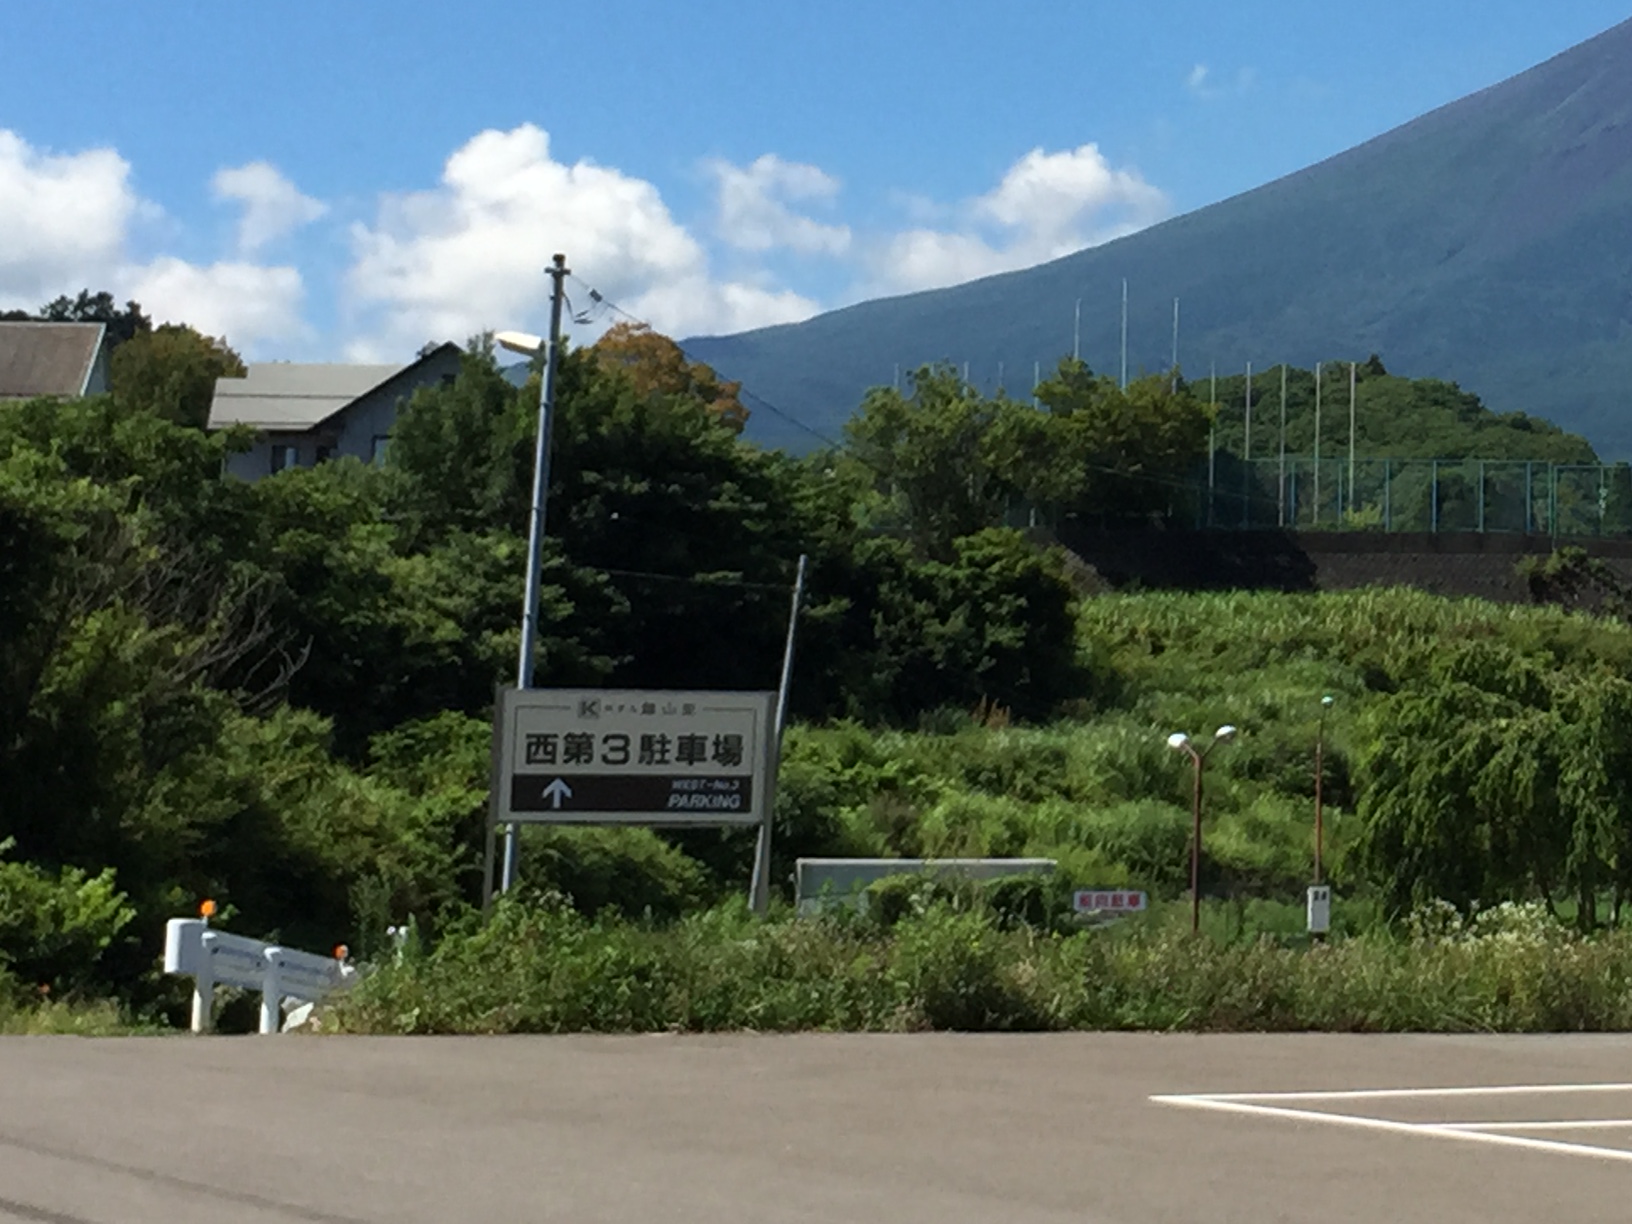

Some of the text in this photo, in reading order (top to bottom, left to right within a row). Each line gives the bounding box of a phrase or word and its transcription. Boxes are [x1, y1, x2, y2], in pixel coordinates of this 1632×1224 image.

[525, 731, 745, 767] 西第3駐車場
[667, 794, 741, 809] PARKING
